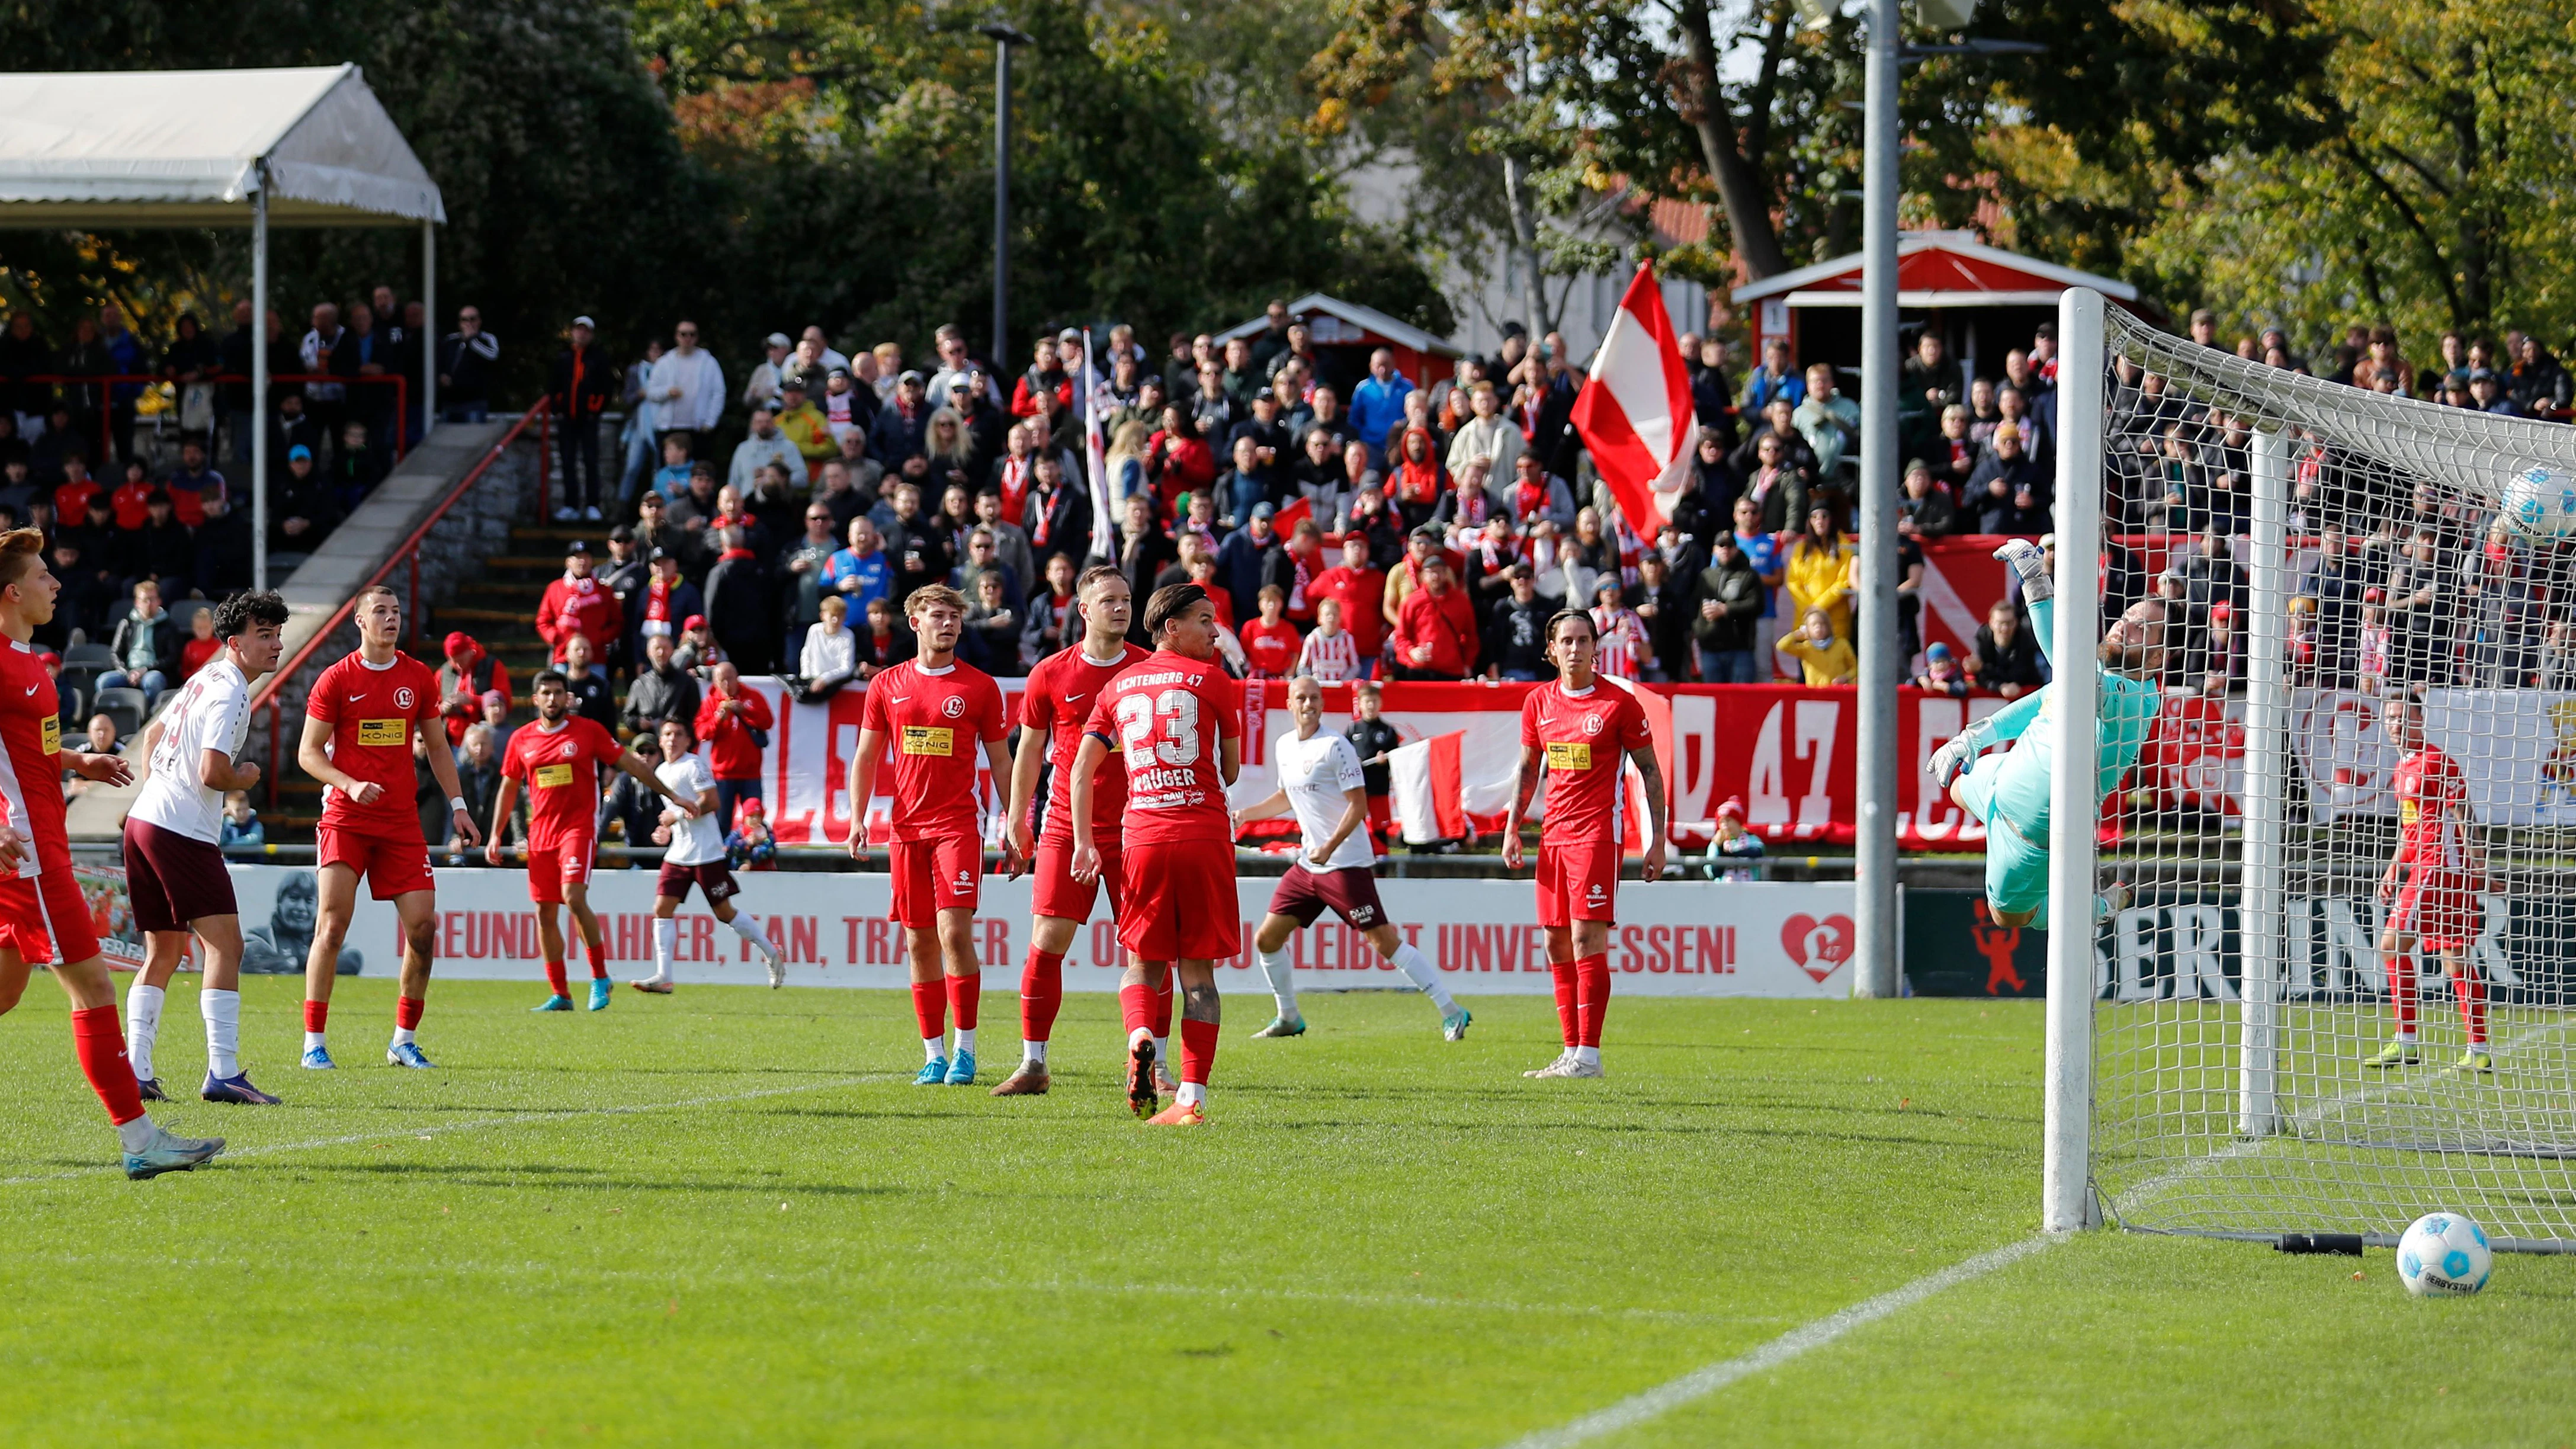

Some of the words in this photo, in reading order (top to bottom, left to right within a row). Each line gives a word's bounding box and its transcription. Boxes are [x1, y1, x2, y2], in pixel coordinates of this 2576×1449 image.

[1117, 672, 1183, 693] LICHTENBERG
[1186, 674, 1203, 687] 47
[1117, 690, 1199, 772] 23
[1339, 767, 1361, 780] DWB
[1747, 698, 1840, 838] 47
[2424, 1272, 2474, 1291] DERBYSTAR
